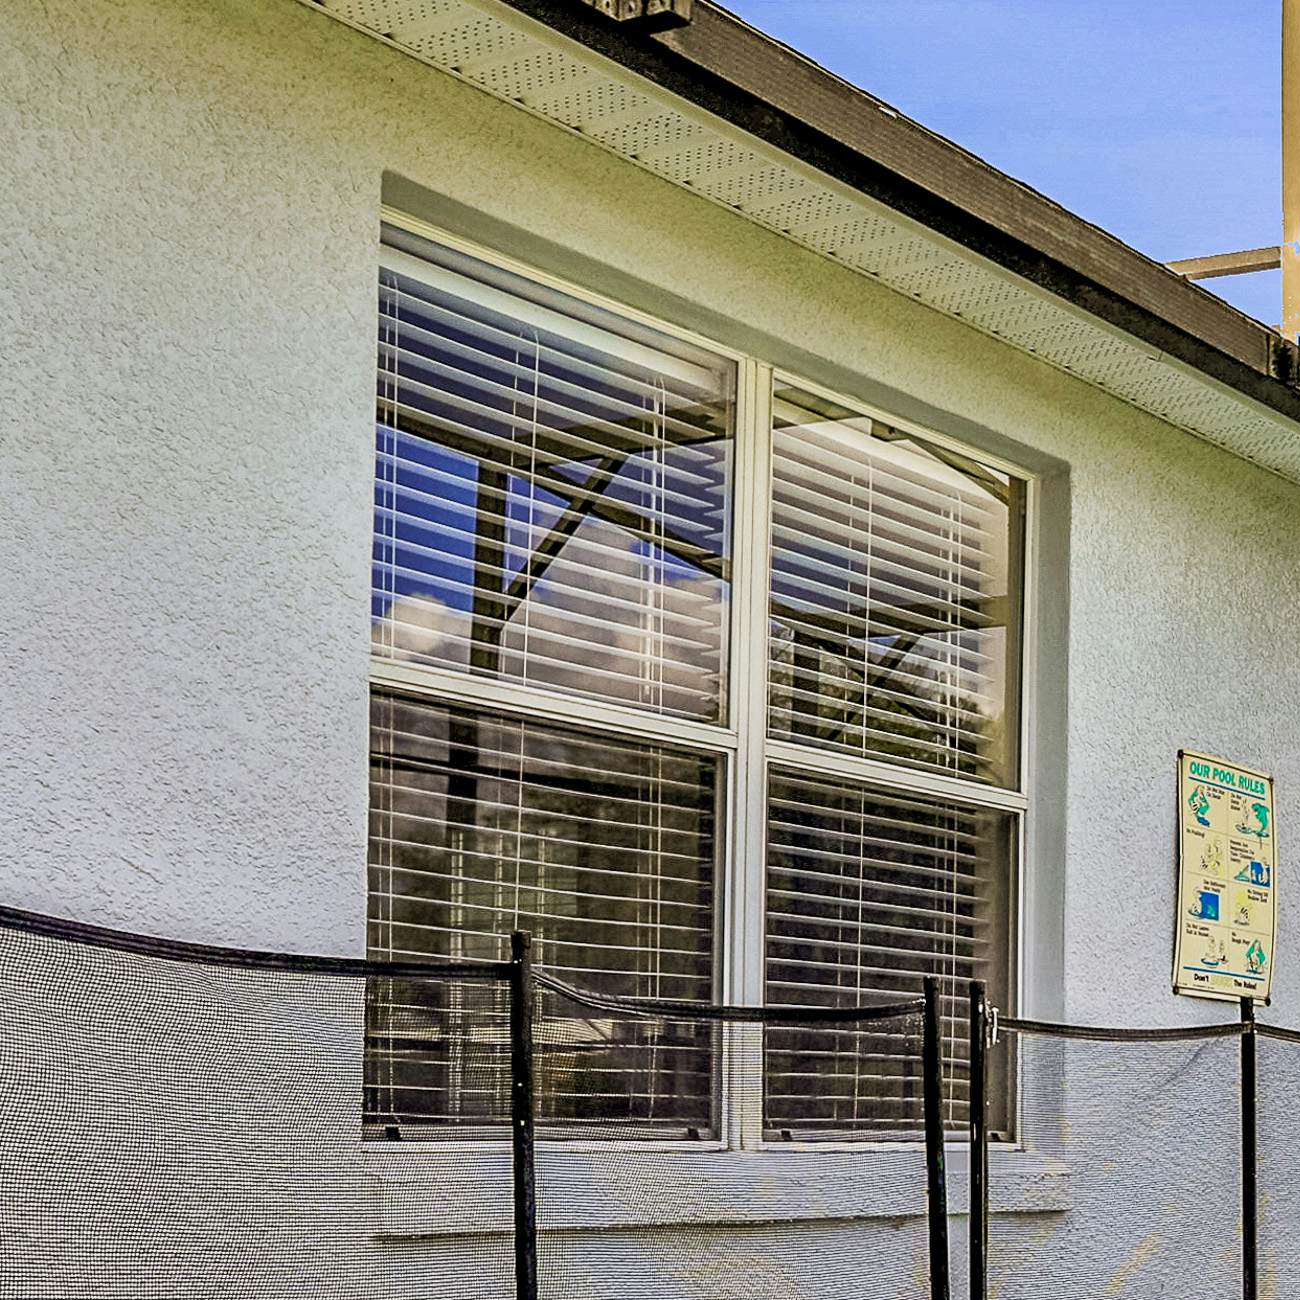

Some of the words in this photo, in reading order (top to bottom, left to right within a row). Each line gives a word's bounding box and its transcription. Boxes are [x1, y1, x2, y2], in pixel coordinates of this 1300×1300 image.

[1190, 762, 1210, 778] OUR
[1213, 768, 1236, 785] POOL
[1238, 776, 1265, 794] RULES
